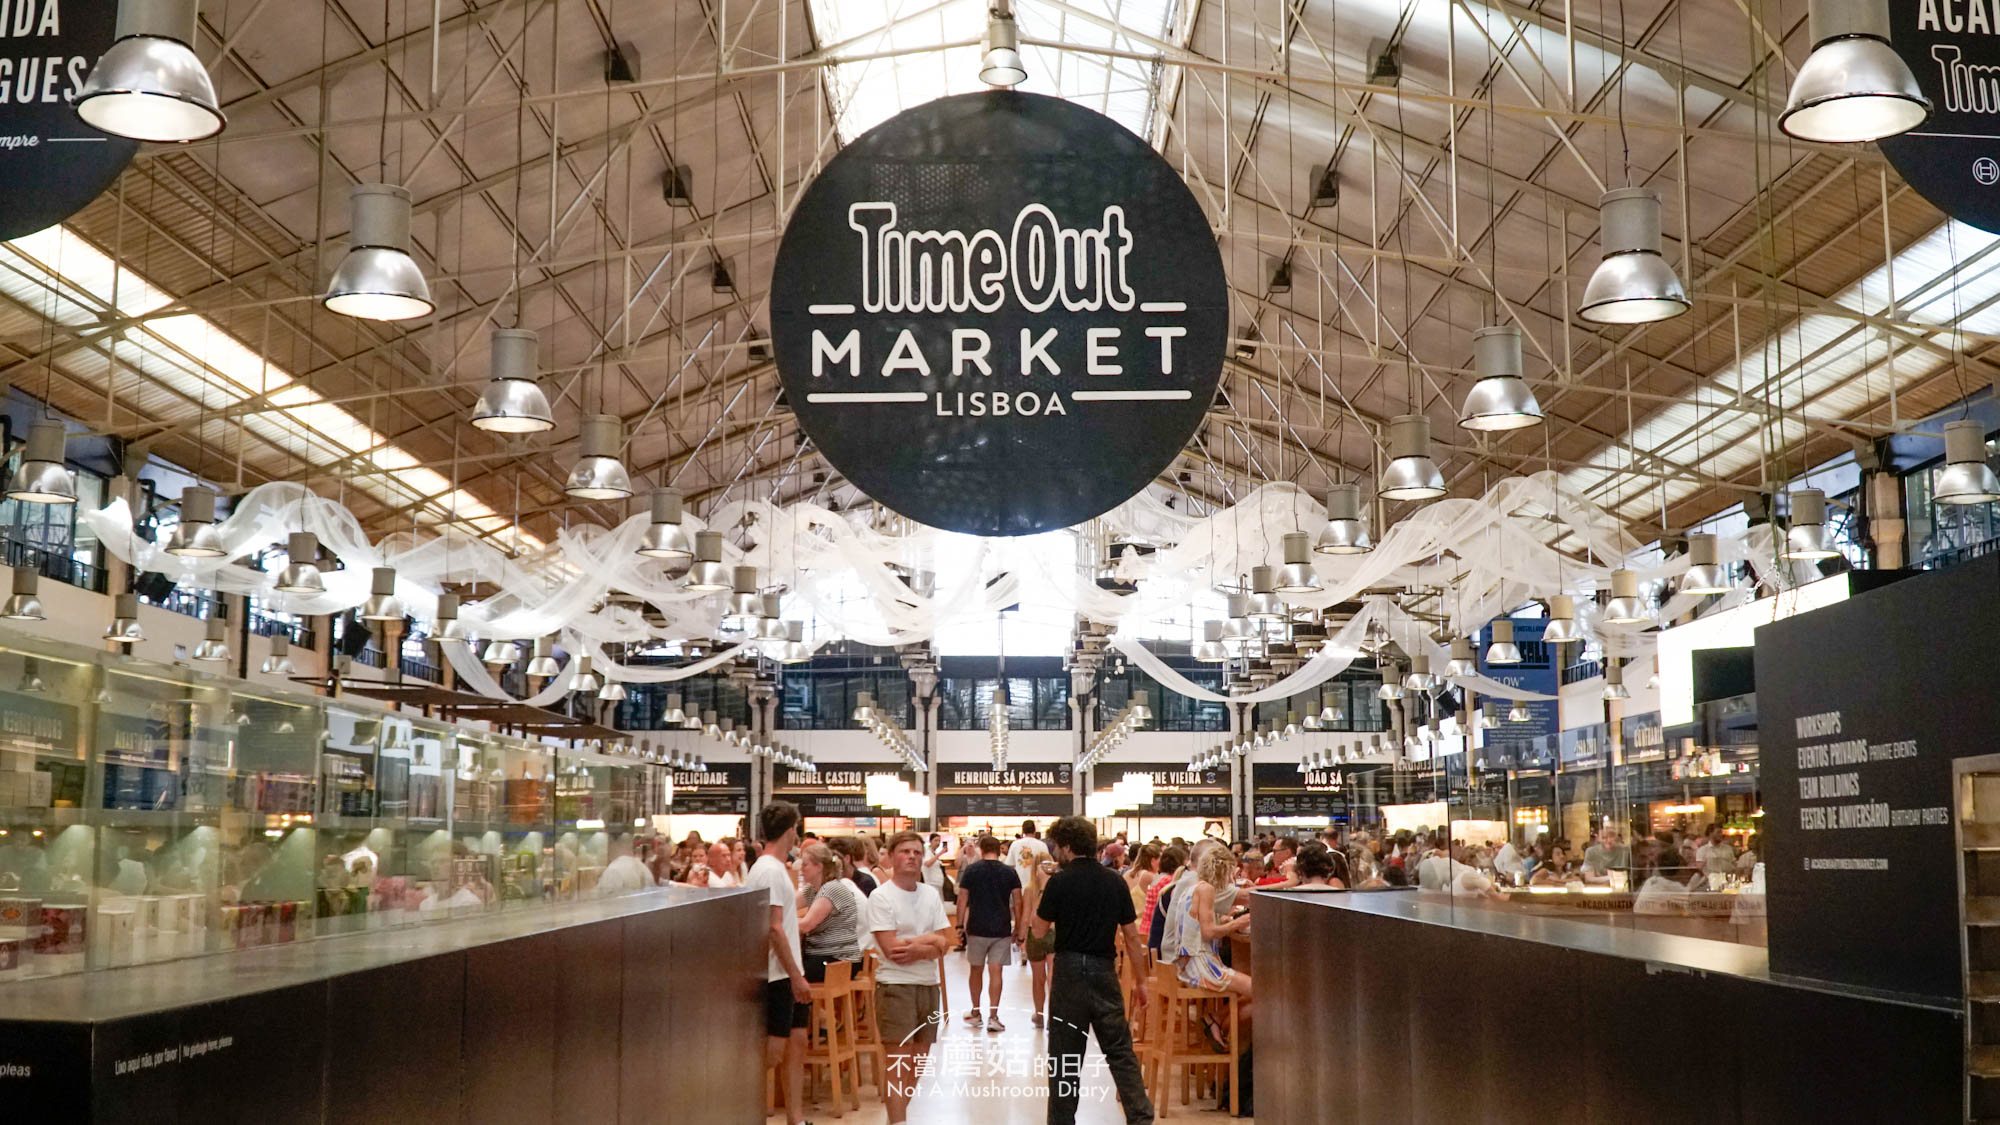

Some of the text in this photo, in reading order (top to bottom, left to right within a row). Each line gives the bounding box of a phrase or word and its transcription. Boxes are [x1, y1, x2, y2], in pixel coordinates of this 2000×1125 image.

[0, 56, 103, 103] GUES
[848, 202, 1136, 314] Time Out
[811, 327, 1187, 377] MARKET
[936, 391, 1067, 417] LISBOA
[1796, 711, 1841, 739] WORKSHOPS
[1797, 744, 1829, 769] EVENTOS
[1830, 739, 1868, 766] PRIVADOS
[1893, 740, 1918, 759] EVENTS
[674, 772, 728, 785] FELICIDADE
[788, 771, 823, 784] MIGUEL
[825, 771, 862, 784] CASTRO
[955, 771, 1001, 785] HENRIQUE
[1003, 769, 1016, 784] SÁ
[1019, 771, 1055, 784] PESSOA
[1169, 771, 1202, 784] VIEIRA
[1304, 770, 1342, 785] JOÃO SÁ
[1799, 772, 1860, 799] TEAM BUILDINGS
[1801, 807, 1826, 830] FESTAS
[1827, 806, 1838, 829] DE
[1839, 798, 1890, 829] ANIVERSÁRIO
[115, 1060, 127, 1076] Lixo
[127, 1056, 140, 1074] aqui
